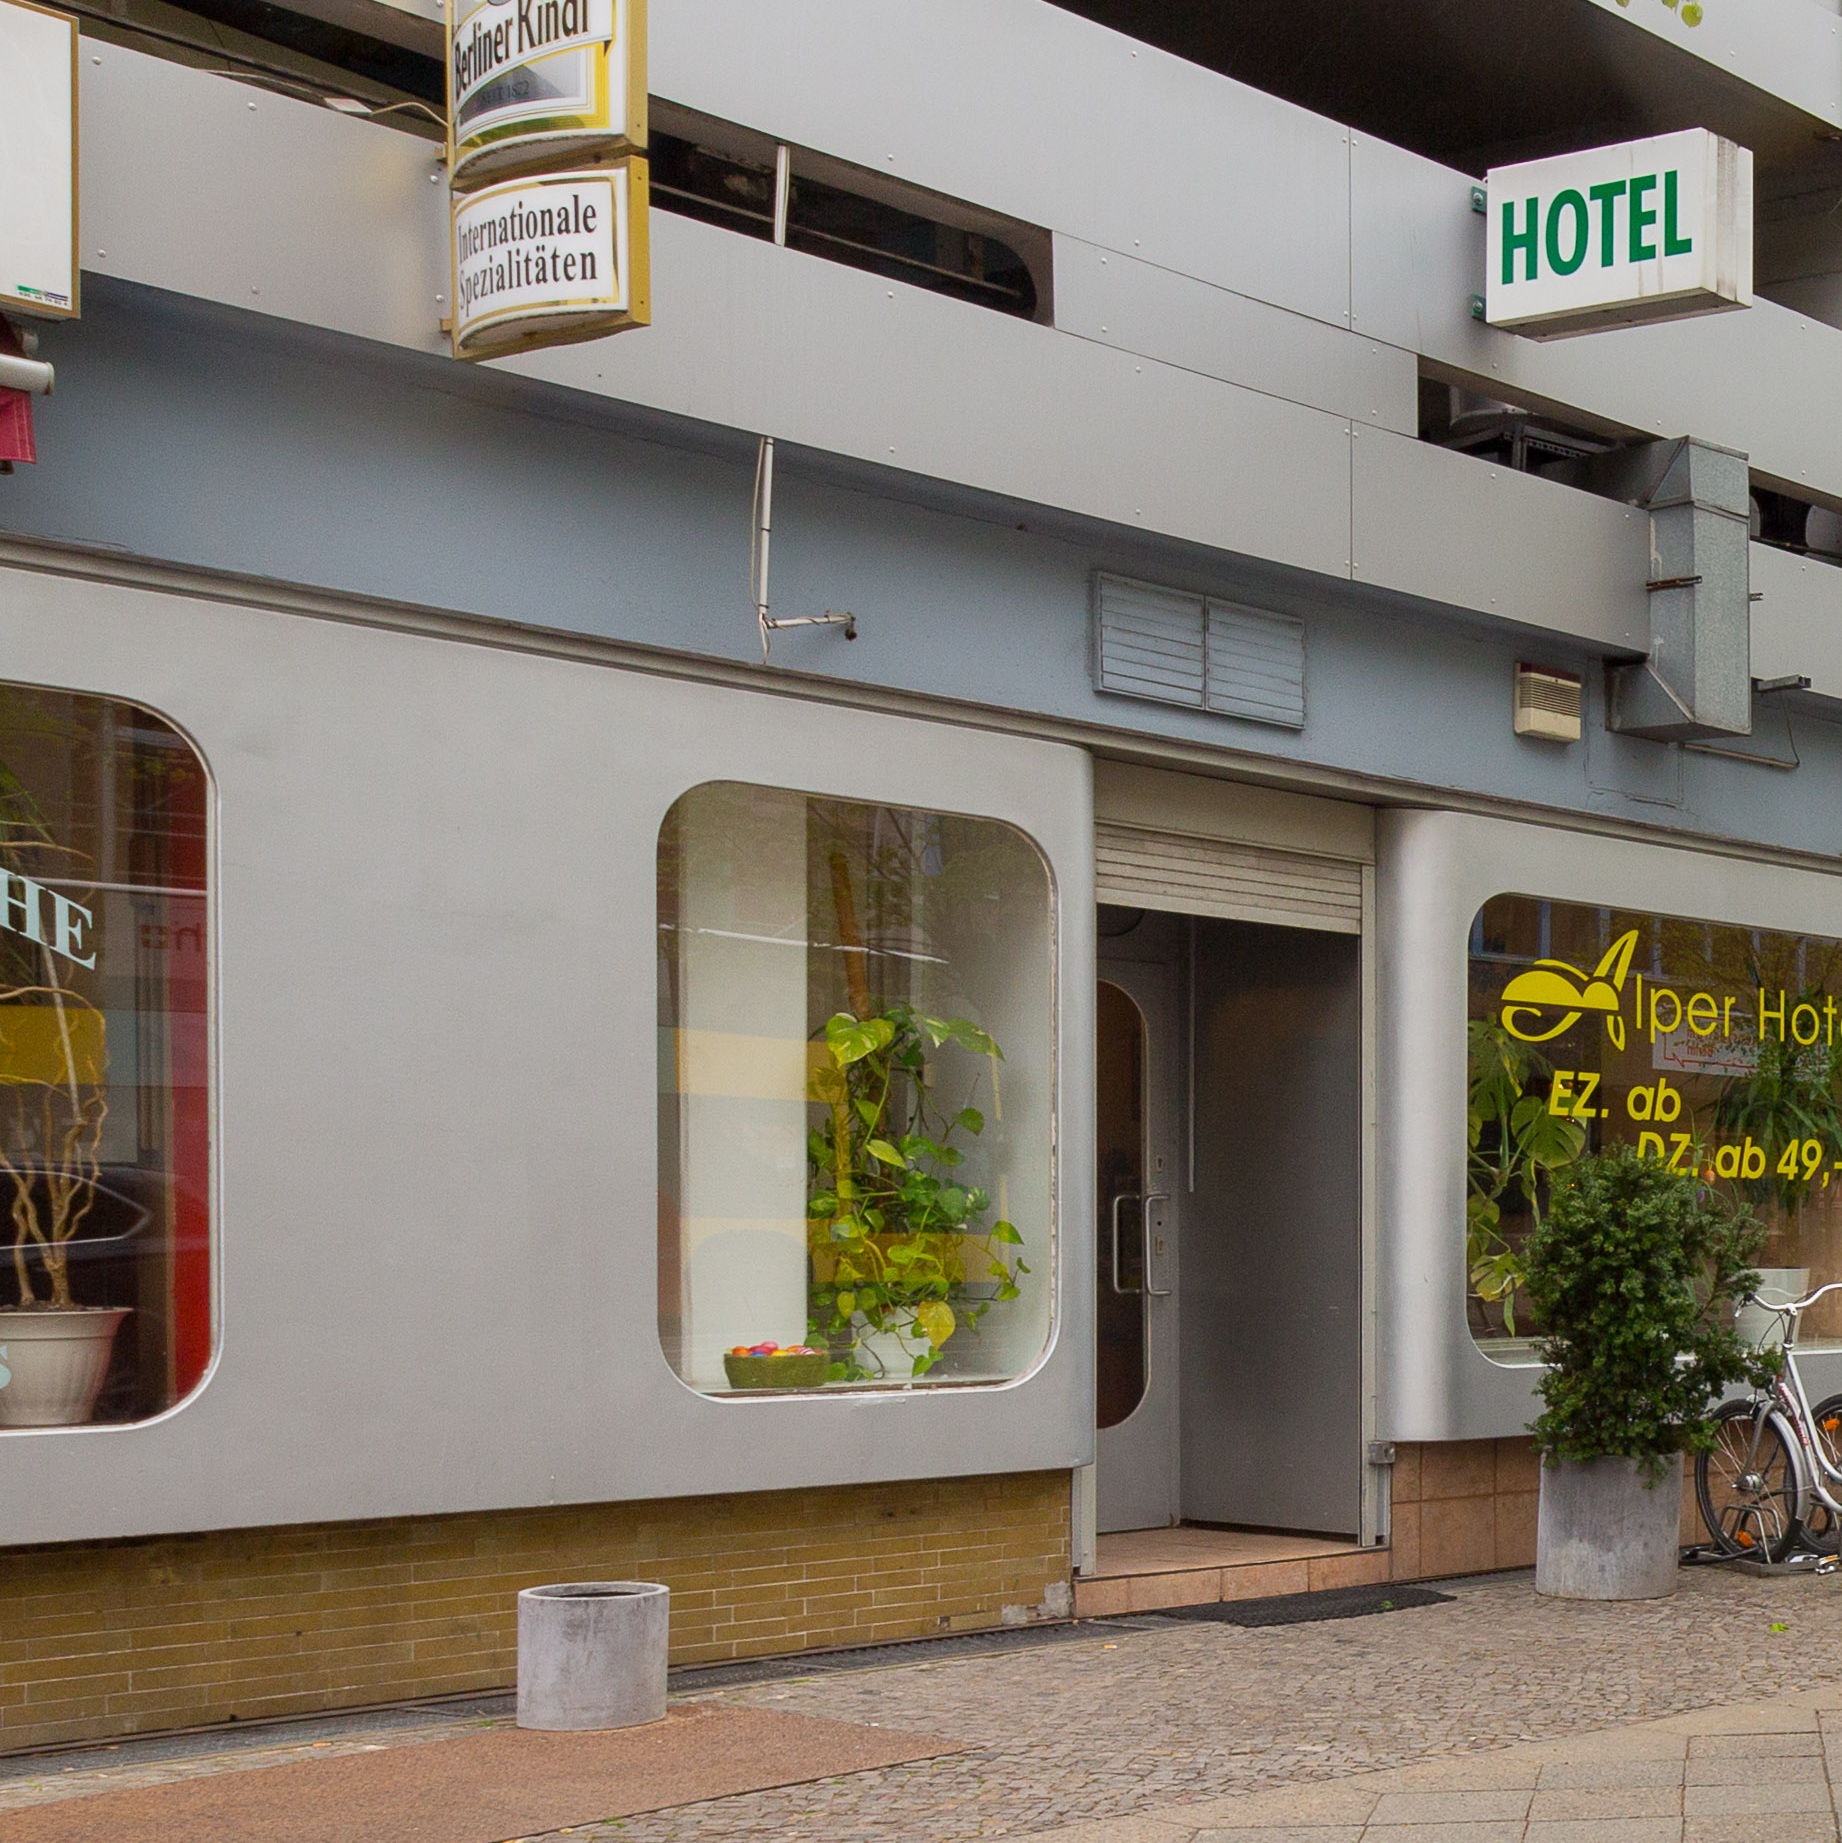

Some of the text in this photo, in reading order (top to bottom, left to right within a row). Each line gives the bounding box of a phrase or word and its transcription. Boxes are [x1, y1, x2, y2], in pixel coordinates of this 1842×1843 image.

[455, 17, 513, 101] Berliner
[458, 194, 597, 265] Internationale
[1500, 170, 1693, 285] HOTEL
[459, 244, 598, 318] Spezialitäten
[1548, 1070, 1681, 1123] EZ. ab
[1715, 1136, 1766, 1179] ab
